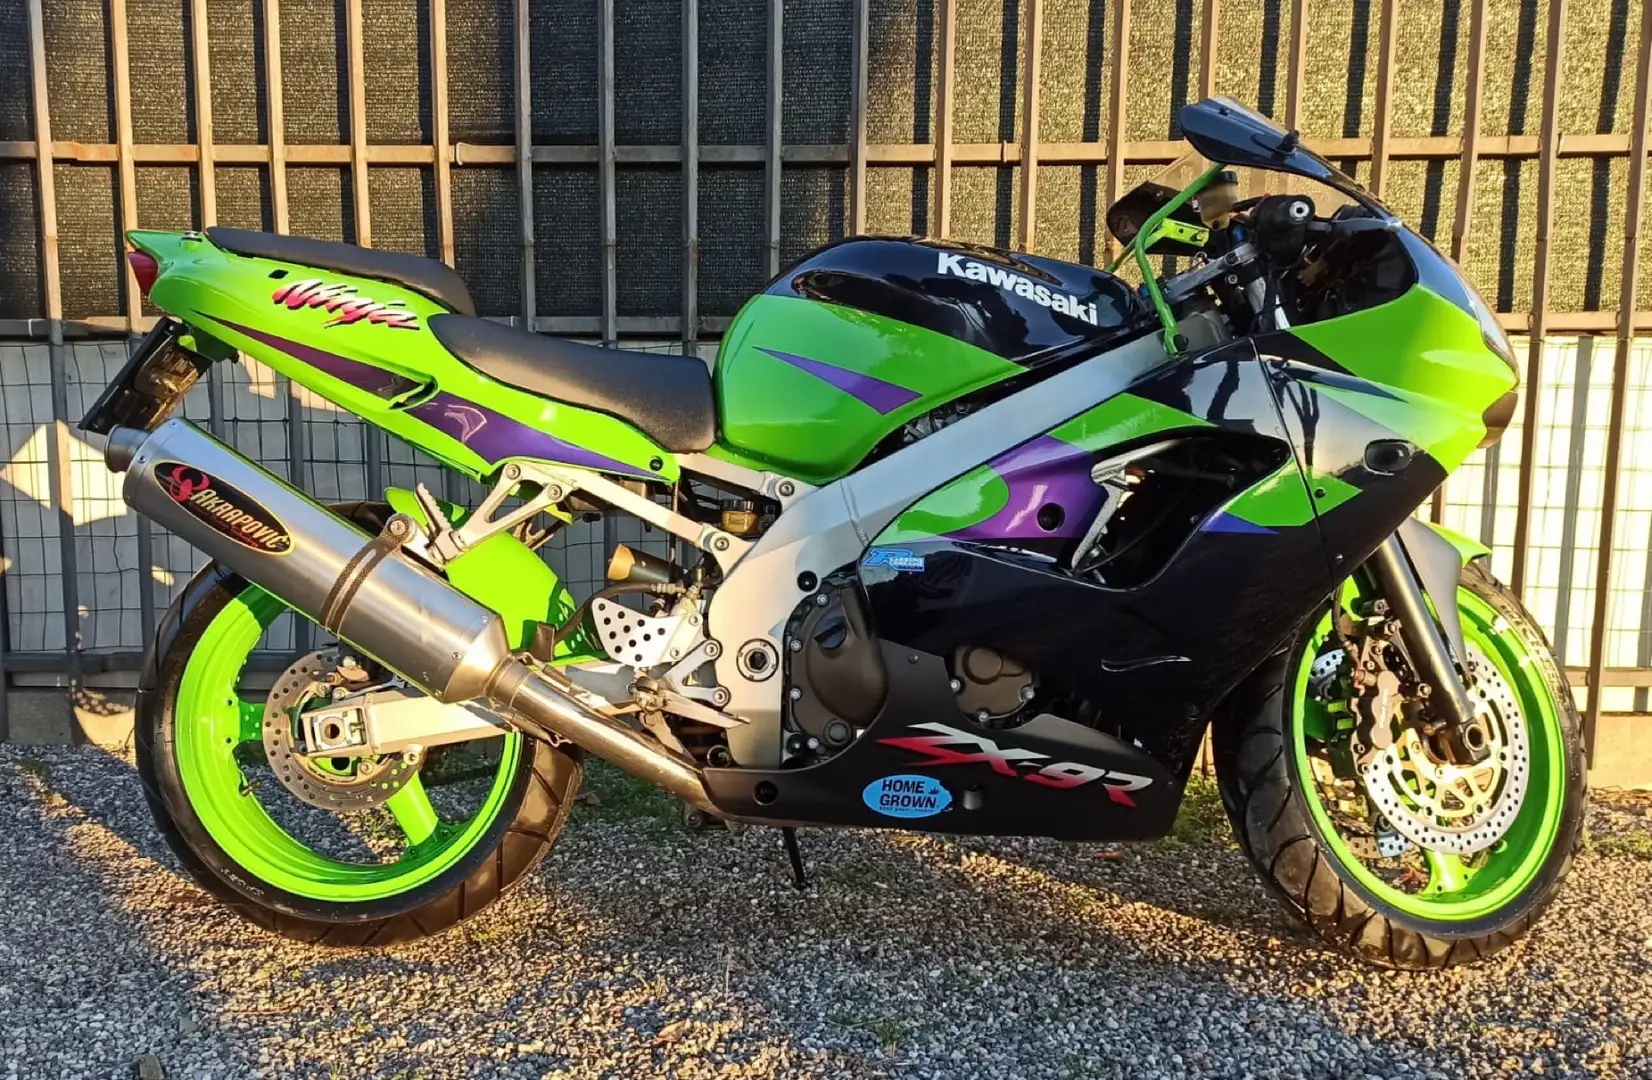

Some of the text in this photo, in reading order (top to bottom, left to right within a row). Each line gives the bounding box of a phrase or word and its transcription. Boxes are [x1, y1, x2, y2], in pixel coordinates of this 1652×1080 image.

[272, 279, 420, 330] Ninja
[937, 251, 1098, 325] Kawasaki
[876, 722, 1153, 808] ZX-9R
[881, 779, 925, 794] HOME
[879, 793, 937, 809] GROWN
